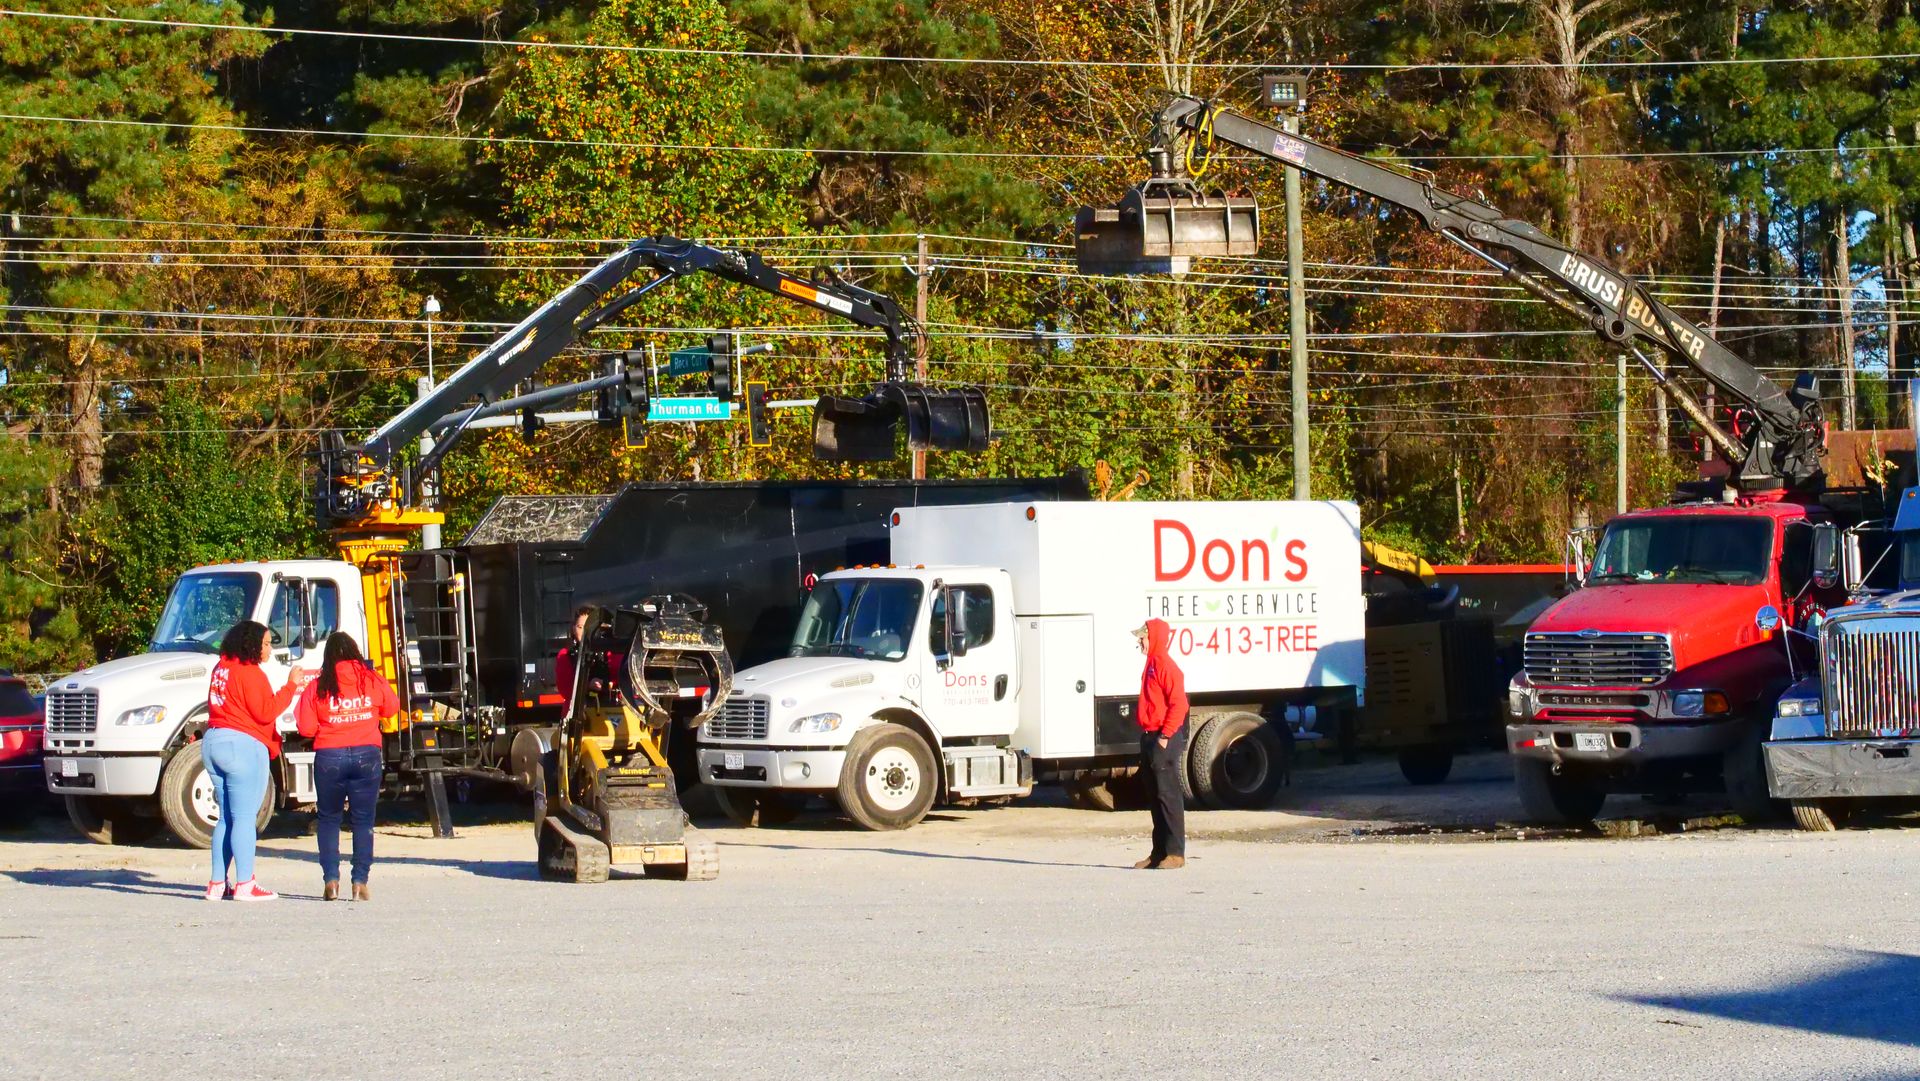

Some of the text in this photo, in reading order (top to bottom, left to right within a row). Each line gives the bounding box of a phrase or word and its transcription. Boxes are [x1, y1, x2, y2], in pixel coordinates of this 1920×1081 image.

[650, 403, 702, 415] Thurman
[1153, 519, 1308, 582] Don's
[1147, 592, 1317, 617] TREE SERVICE
[659, 630, 703, 643] Vermeer
[1167, 625, 1318, 656] 70-413-TREE
[945, 671, 988, 687] Dons
[329, 695, 372, 710] Don's
[619, 767, 651, 775] Vermeer
